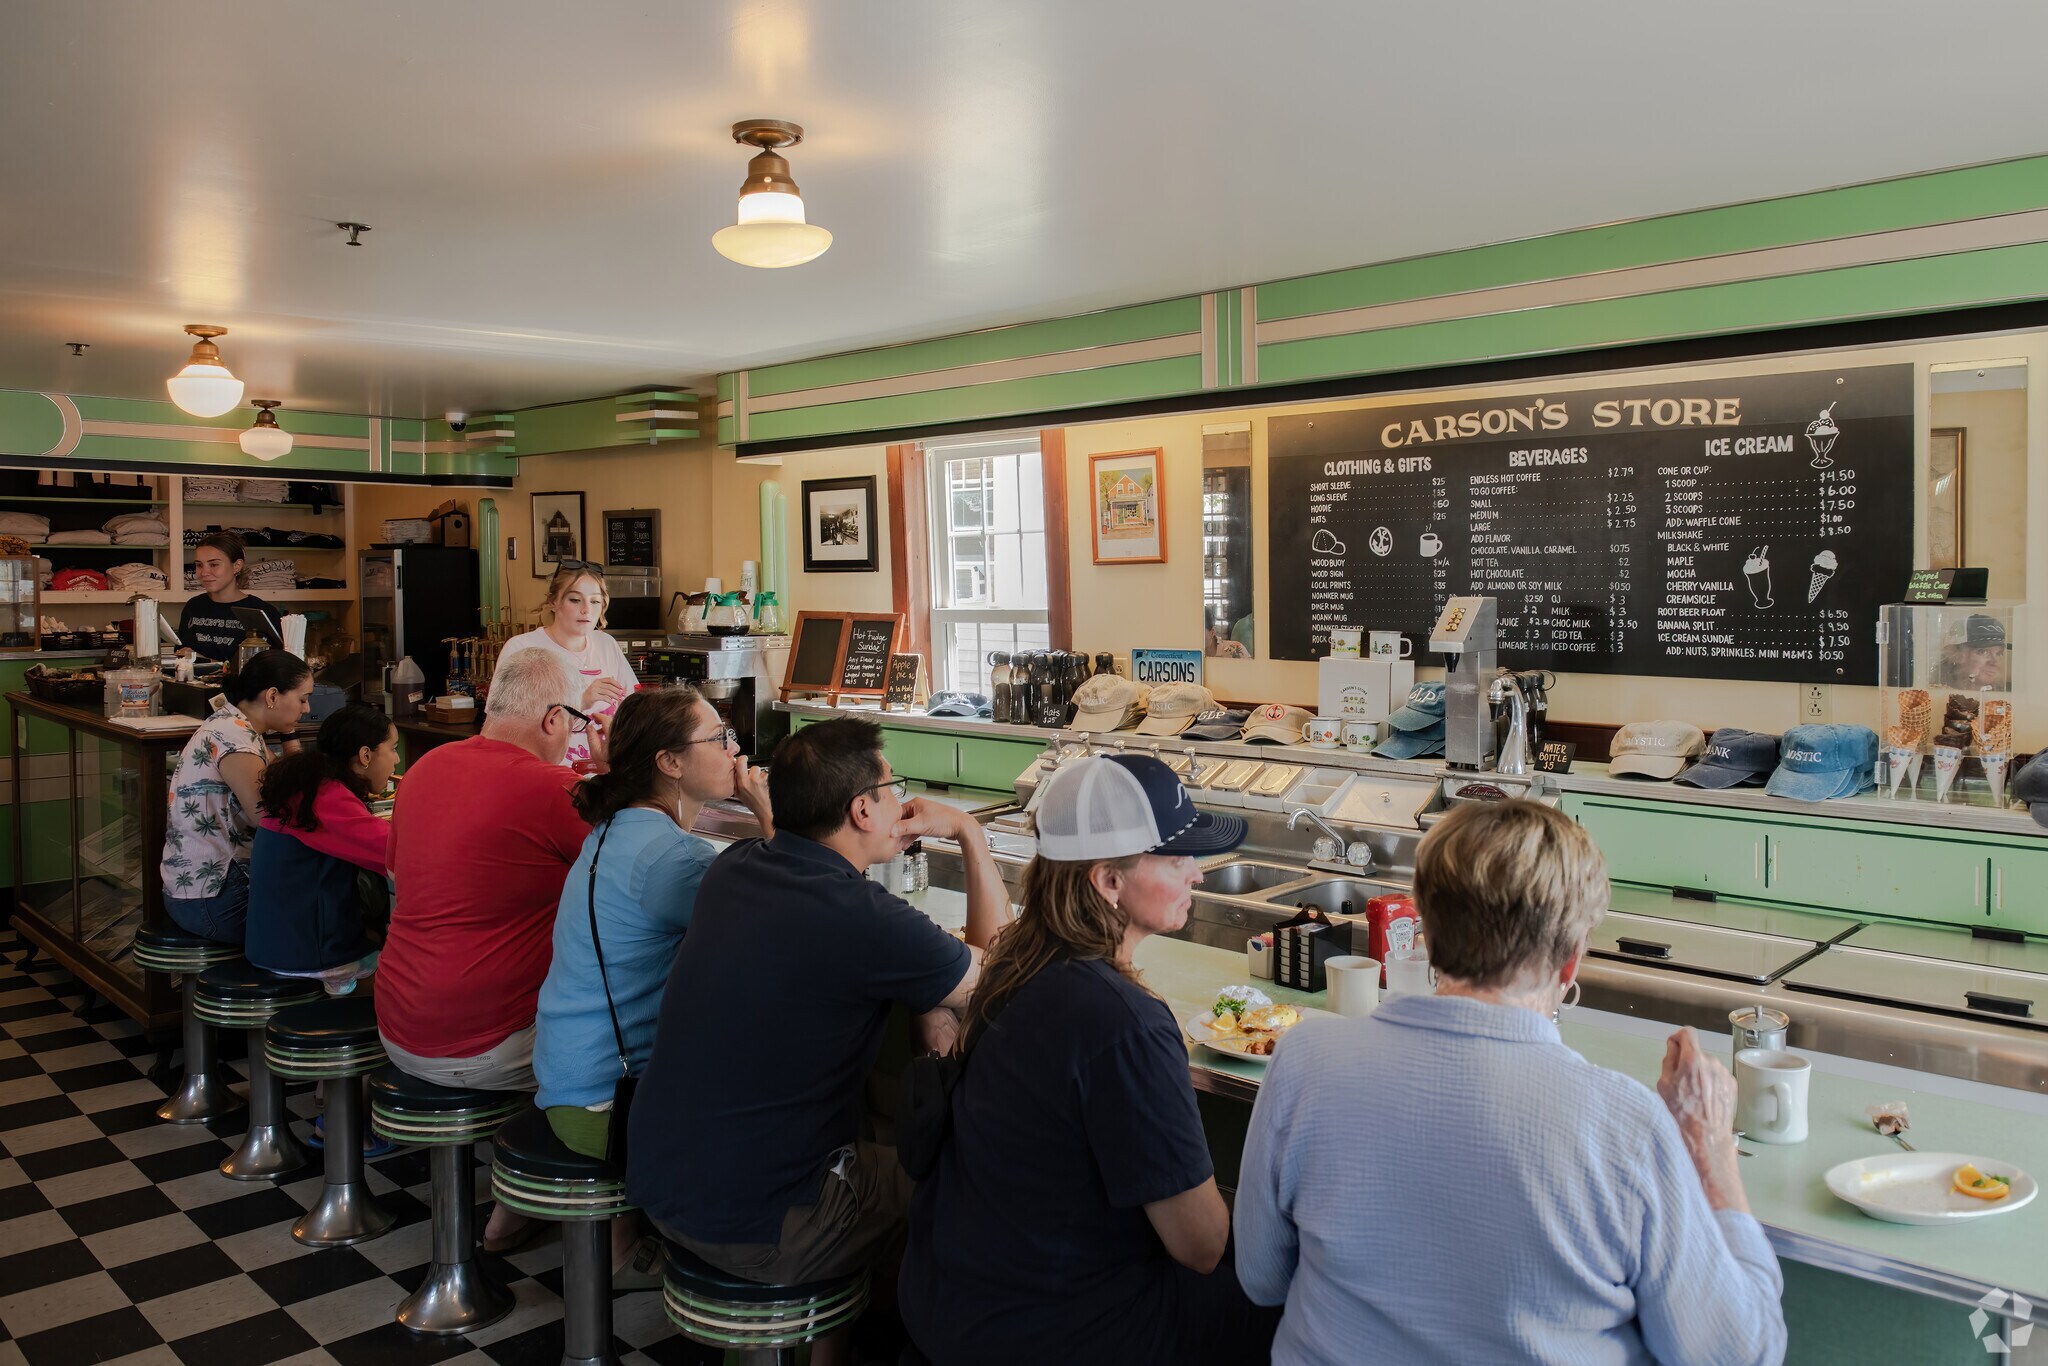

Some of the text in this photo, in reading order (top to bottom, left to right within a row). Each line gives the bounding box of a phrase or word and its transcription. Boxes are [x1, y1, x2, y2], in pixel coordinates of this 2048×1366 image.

[1380, 397, 1742, 448] CARSON'S STORE
[1705, 435, 1794, 457] ICE CREAM
[1509, 447, 1588, 467] BEVERAGES
[1324, 456, 1432, 476] CLOTHING & GIFTS
[1657, 465, 1712, 476] CONE OR CUP:
[1470, 466, 1634, 485] ENDLESS HOT COFFEE $2.79
[1665, 469, 1856, 488] 1 SCOOP $4.50
[1310, 477, 1446, 492] SHORT SLEEVE $25
[1470, 486, 1518, 496] TO GO COFFEE:
[1665, 485, 1856, 502] 2 SCOOPS $6.00
[1310, 494, 1326, 502] LONG
[1326, 493, 1348, 502] SLEEVE
[1470, 492, 1635, 508] SMALL $2.25
[1310, 499, 1450, 514] HOODIE $60
[1665, 499, 1855, 514] 3 SCOOPS $7.50
[1470, 505, 1637, 520] MEDIUM $2.50
[1310, 515, 1327, 524] HATS
[1470, 518, 1636, 532] LARGE $2.75
[1665, 513, 1843, 527] ADD: WAFFLE CONE $1.00
[1657, 525, 1851, 540] MILKSHAKE $8.50
[1470, 535, 1484, 543] ADD
[1470, 545, 1510, 555] CHOCOLATE,
[1543, 545, 1577, 554] CARAMEL
[1667, 542, 1730, 553] BLACK & WHITE
[1311, 559, 1329, 568] WOOD
[1329, 559, 1346, 568] BUOY
[1471, 557, 1630, 567] HOT TEA $2
[1667, 556, 1694, 566] MAPLE
[1311, 569, 1446, 578] WOOD SIGN $25
[1470, 569, 1630, 579] HOT CHOCOLATE $2
[1667, 568, 1696, 579] MOCHA
[1914, 571, 1939, 581] Dipped
[1311, 581, 1447, 591] LOCAL PRINTS $35
[1487, 581, 1515, 590] ALMOND
[1517, 581, 1527, 590] OR
[1528, 581, 1542, 590] SOY
[1544, 581, 1562, 590] MILK
[1666, 581, 1734, 592] CHERRY VANILLA
[1908, 581, 1951, 590] Waffle Cone
[1311, 592, 1354, 601] NOANKER MUG
[1551, 595, 1561, 604] OJ
[1666, 595, 1716, 605] CREAMSICLE
[1914, 591, 1927, 600] $2
[1311, 603, 1344, 611] DINER MUG
[1551, 607, 1570, 616] MILK
[1312, 614, 1348, 622] NOANK MUG
[1657, 607, 1849, 619] ROOT BEER FLOAT $6.50
[1500, 617, 1520, 627] JUICE
[1551, 618, 1570, 628] CHOC
[1572, 619, 1591, 628] MILK
[1657, 620, 1850, 633] BANANA SPLIT $9.50
[852, 628, 888, 645] Hot Fudge
[1312, 635, 1327, 644] ROCK
[1551, 630, 1567, 640] ICED
[1569, 631, 1582, 640] TEA
[1499, 641, 1528, 650] LIMEADE
[1551, 642, 1567, 651] ICED
[1569, 643, 1596, 652] COFFEE
[1657, 633, 1850, 649] ICE CREAM SUNDAE $7.50
[1150, 650, 1183, 660] Connecticut
[1665, 646, 1684, 656] ADD:
[1758, 650, 1779, 659] MINI
[1782, 650, 1813, 660] M&M'S
[1818, 650, 1844, 661] $0.50
[892, 659, 911, 671] Apple
[1138, 660, 1195, 683] CARSONS
[1043, 706, 1060, 717] Hats
[1197, 710, 1226, 721] GLP
[1543, 742, 1567, 754] WATER
[1625, 737, 1666, 748] MYSTIC
[1539, 752, 1568, 762] BOTTLE
[1542, 761, 1554, 770] $5
